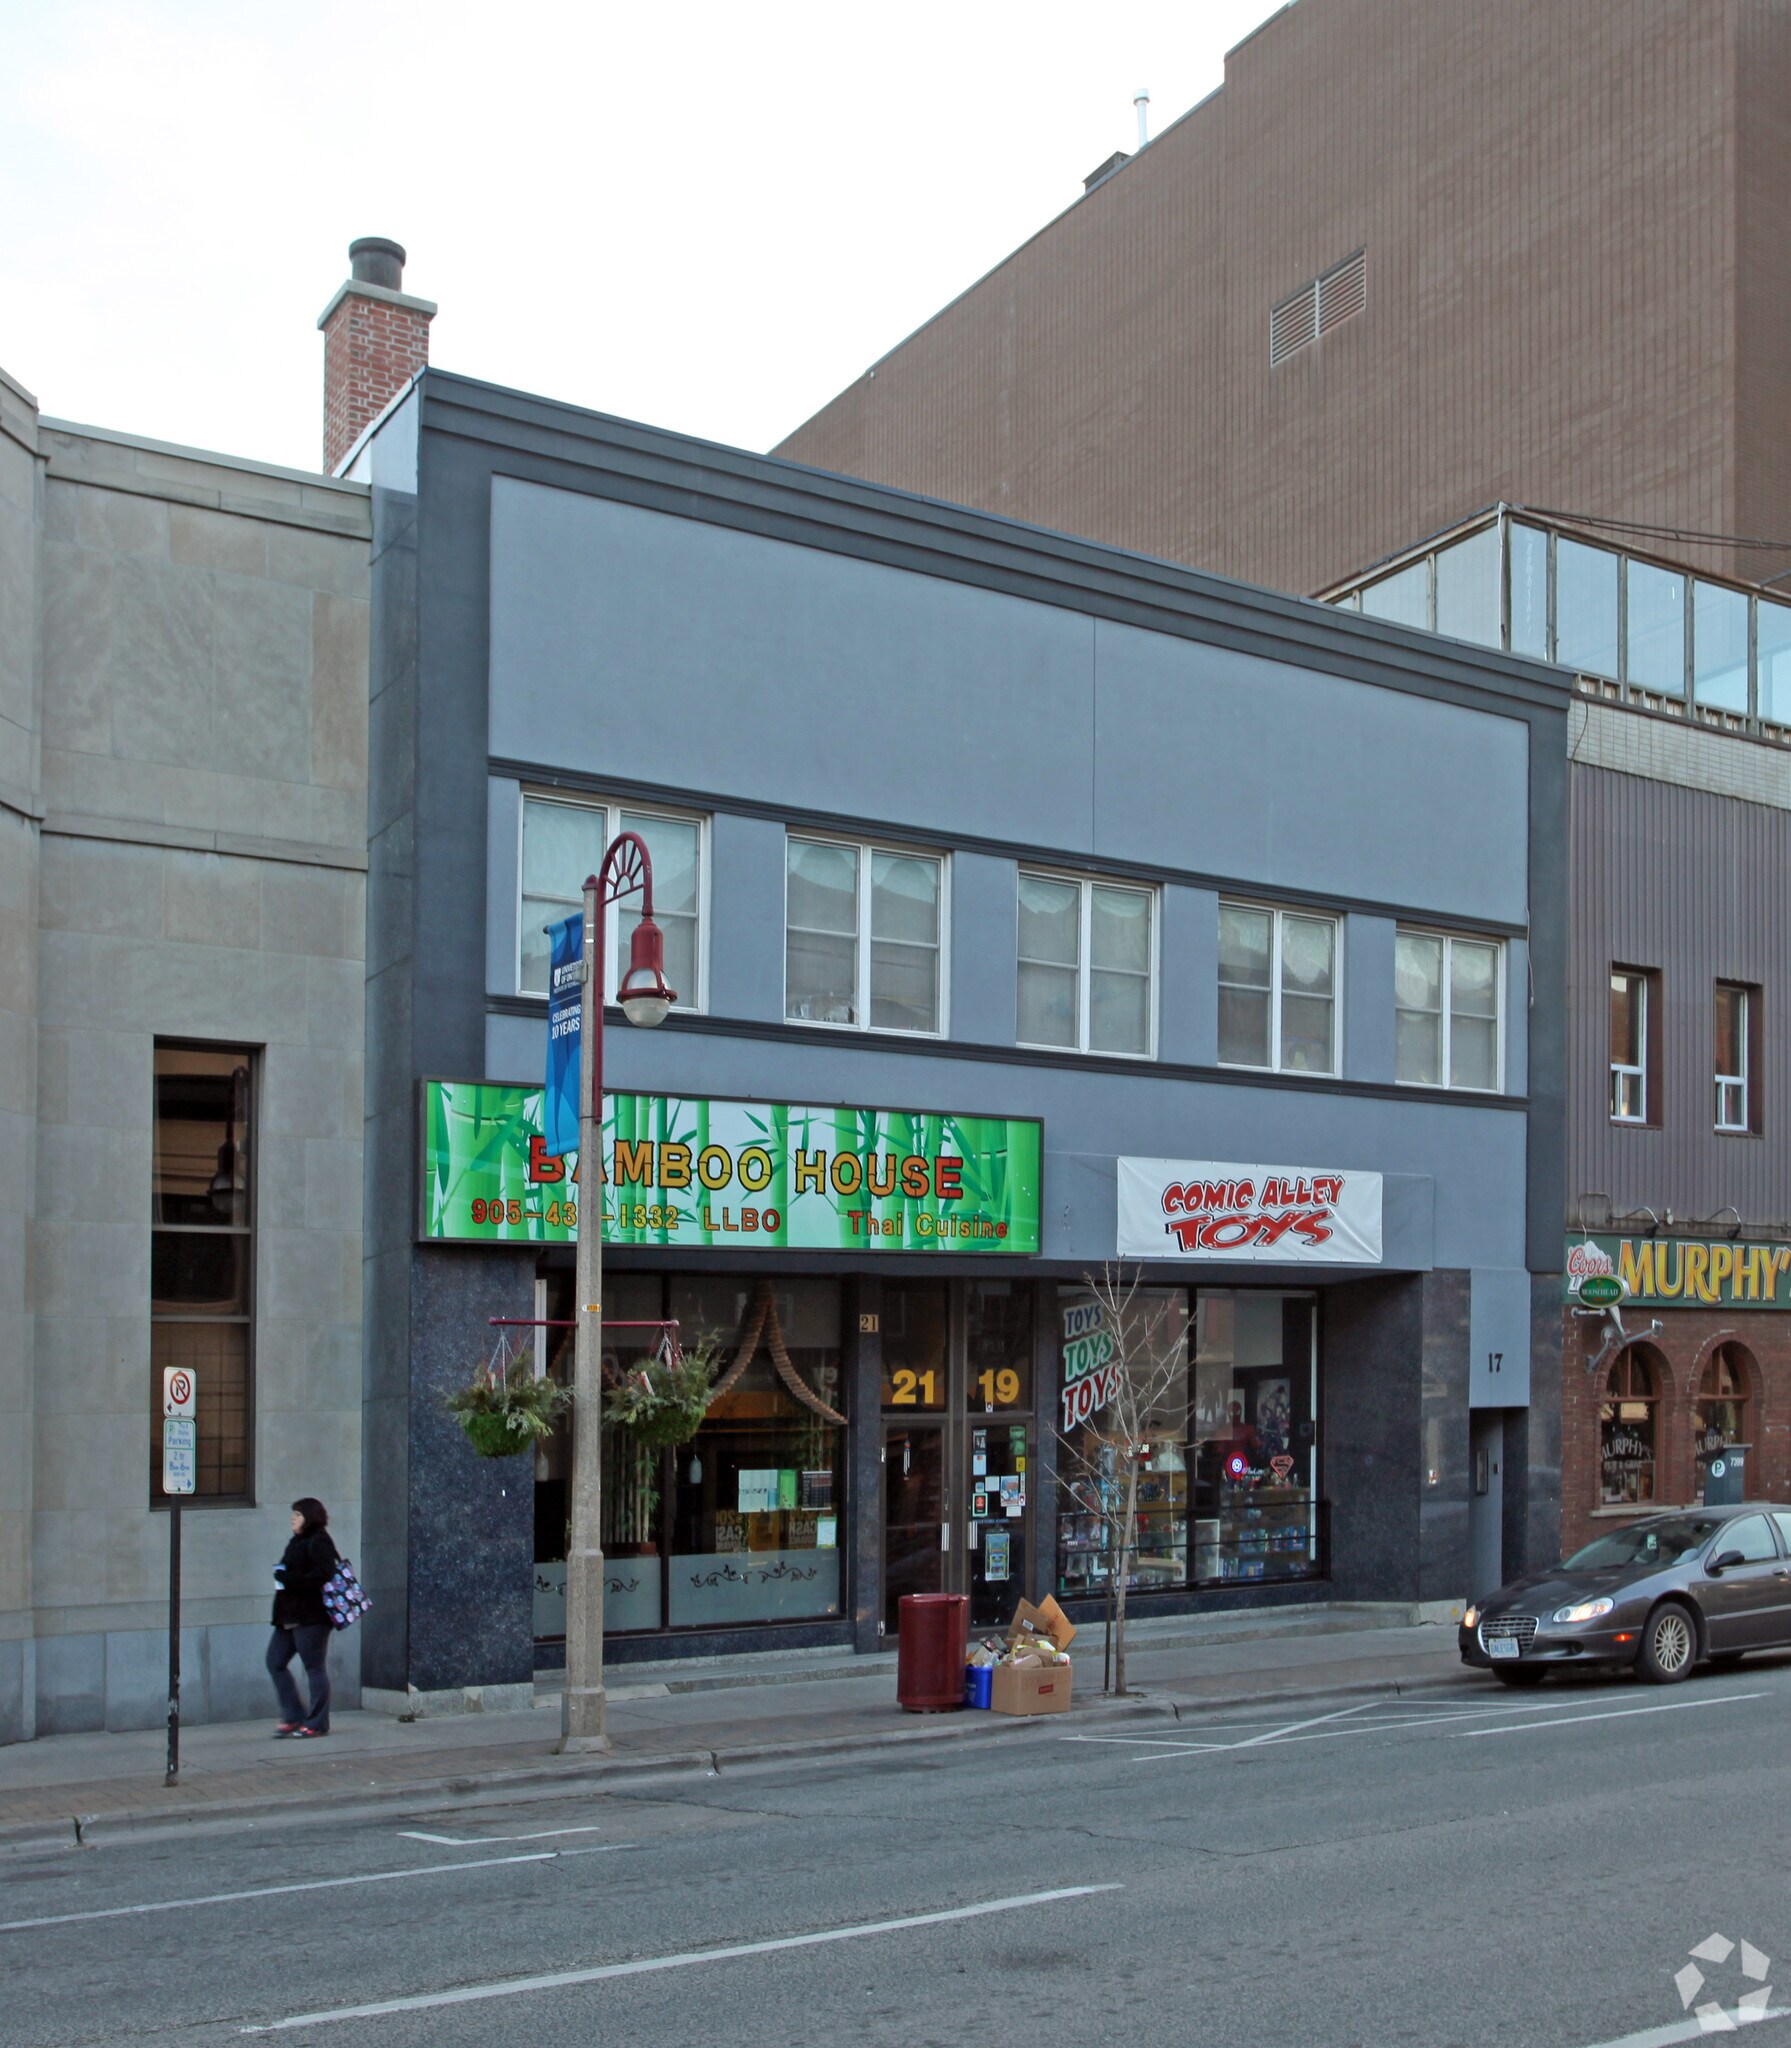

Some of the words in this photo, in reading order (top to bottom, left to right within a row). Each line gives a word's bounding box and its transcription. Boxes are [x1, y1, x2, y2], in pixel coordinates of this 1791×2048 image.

[552, 1004, 582, 1024] CELEBRATING
[552, 1024, 560, 1040] 10
[560, 1017, 580, 1037] YEARS
[795, 1149, 963, 1199] HOUSE
[1162, 1178, 1255, 1215] COMIC
[1260, 1175, 1345, 1209] ALLEY
[471, 1198, 679, 1230] 905-43-1332
[703, 1206, 780, 1233] LLBO
[848, 1210, 903, 1236] Thai
[916, 1213, 1008, 1239] Cuisine
[1165, 1210, 1334, 1252] TOYS
[1567, 1246, 1612, 1276] Coors
[1617, 1239, 1791, 1305] MURPHY'
[1581, 1287, 1619, 1297] MOOSEHEAD
[860, 1315, 878, 1331] 21
[1065, 1303, 1102, 1336] TOYS
[1064, 1331, 1113, 1378] TOYS
[1488, 1352, 1503, 1373] 17
[892, 1369, 934, 1404] 21
[978, 1368, 1020, 1404] 19
[1064, 1359, 1122, 1429] TOYS
